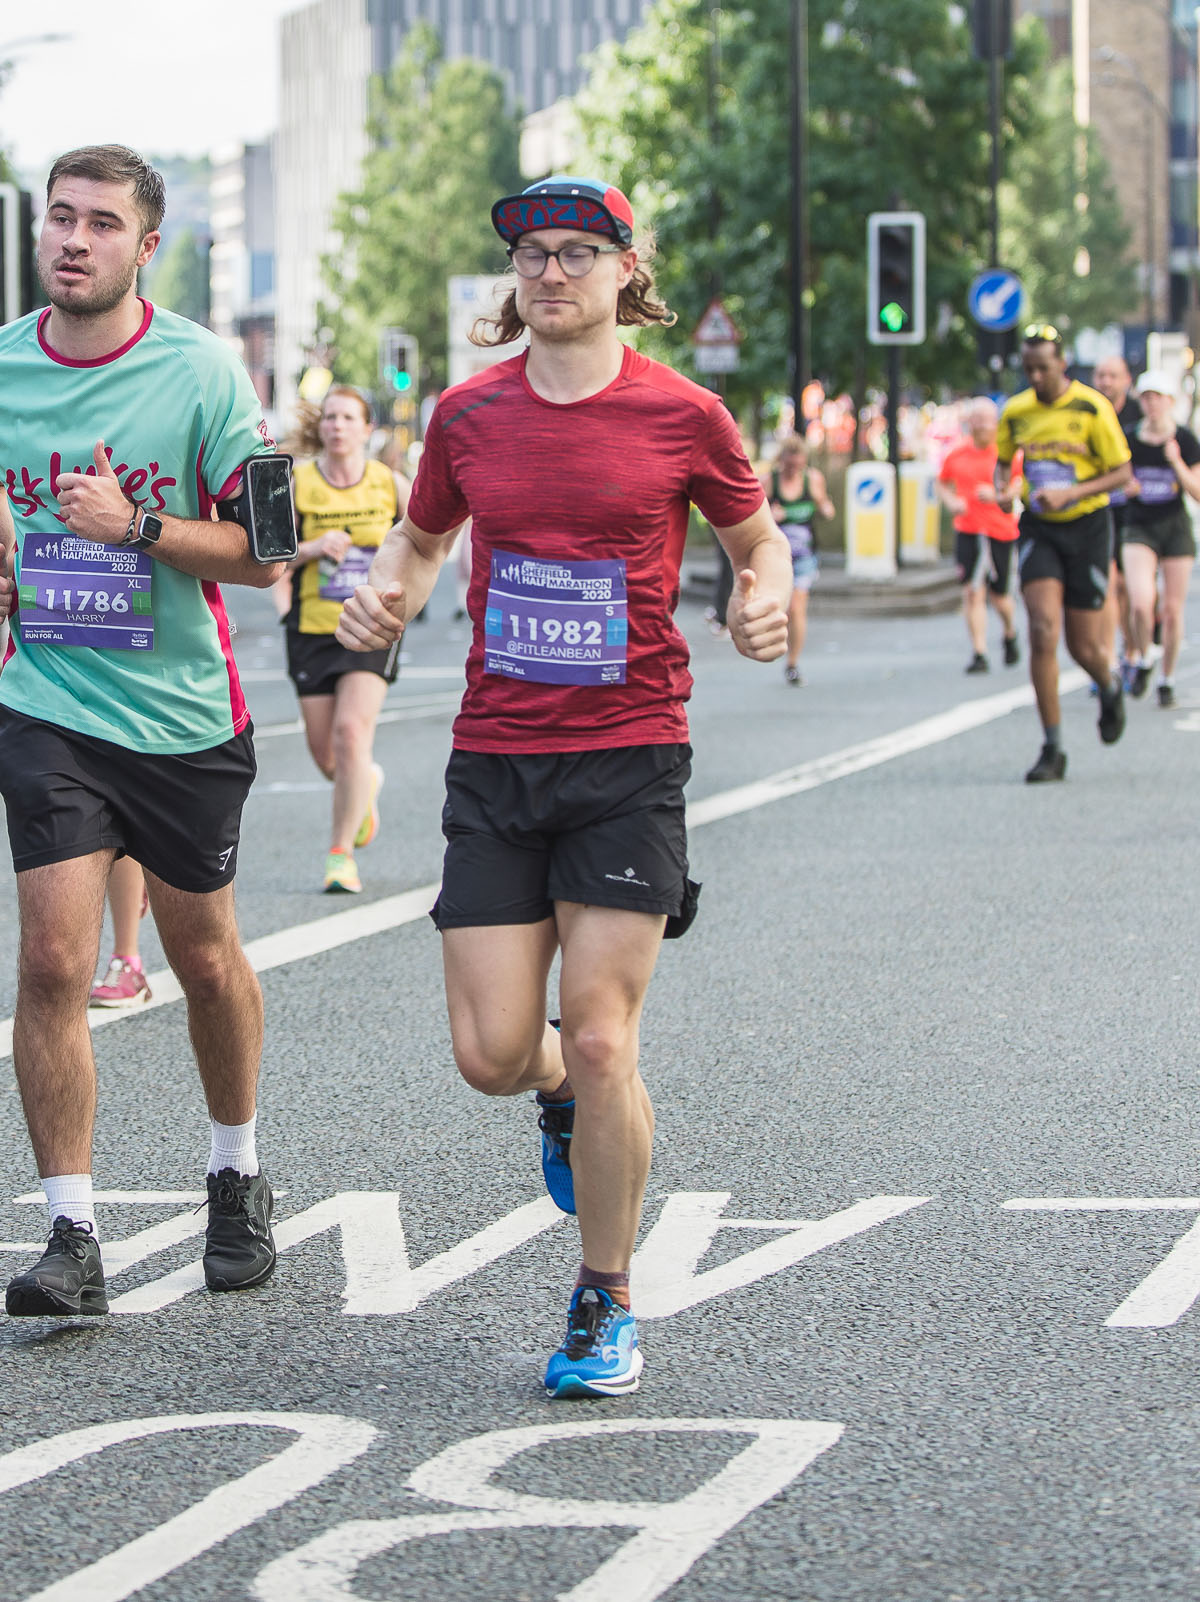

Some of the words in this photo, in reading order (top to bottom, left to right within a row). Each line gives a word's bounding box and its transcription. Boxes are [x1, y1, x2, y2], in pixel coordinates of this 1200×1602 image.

[62, 542, 103, 552] SHEFFIELD
[61, 551, 83, 560] HALF
[83, 553, 137, 562] MARATHON
[111, 562, 137, 572] 2020
[523, 566, 570, 579] SHEFFIELD
[127, 579, 141, 589] XL
[522, 576, 547, 587] HALF
[548, 579, 611, 589] MARATHON
[45, 588, 129, 613] 11786
[582, 590, 612, 600] 2020
[605, 606, 614, 616] S
[66, 613, 106, 623] HARRY
[509, 614, 602, 645] 11982
[507, 640, 601, 659] @FITLEANBEAN
[502, 664, 514, 672] FOR
[514, 667, 526, 675] ALL
